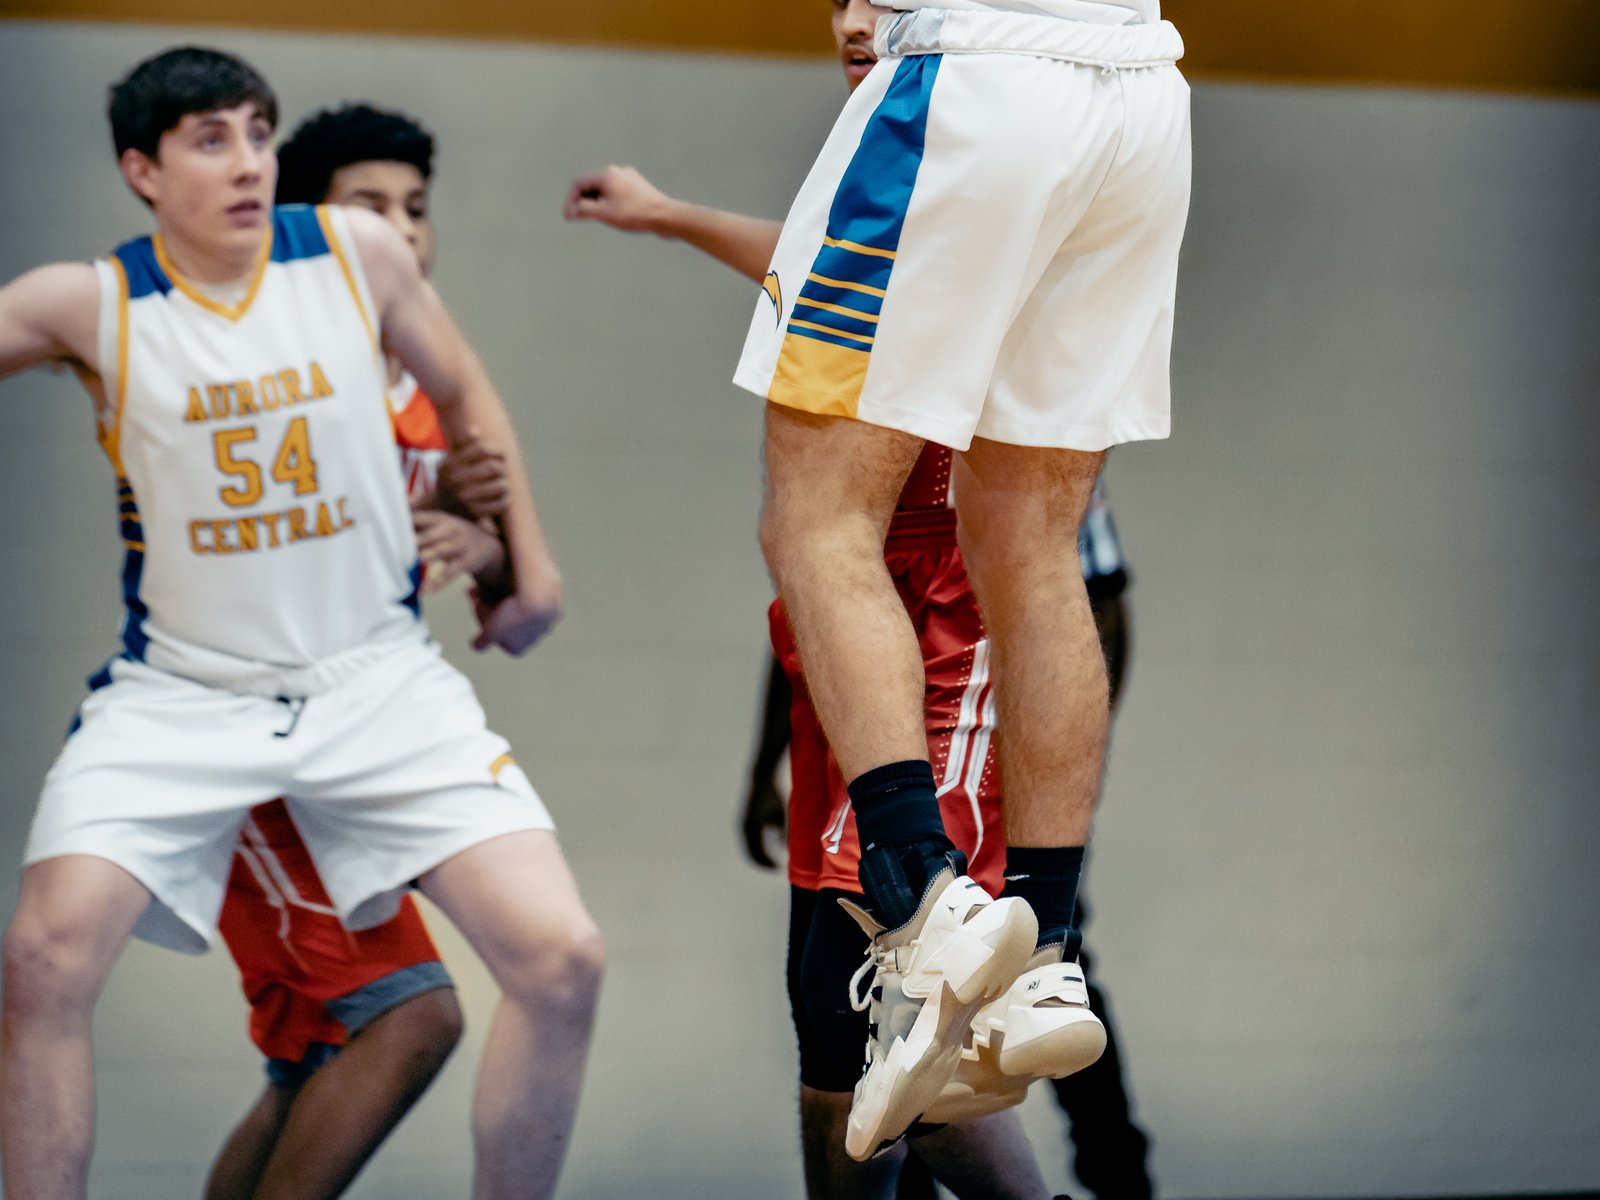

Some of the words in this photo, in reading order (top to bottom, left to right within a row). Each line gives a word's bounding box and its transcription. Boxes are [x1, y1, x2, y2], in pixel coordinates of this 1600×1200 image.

[184, 361, 334, 423] AURORA
[212, 416, 319, 508] 54
[188, 497, 356, 555] CENTRAL
